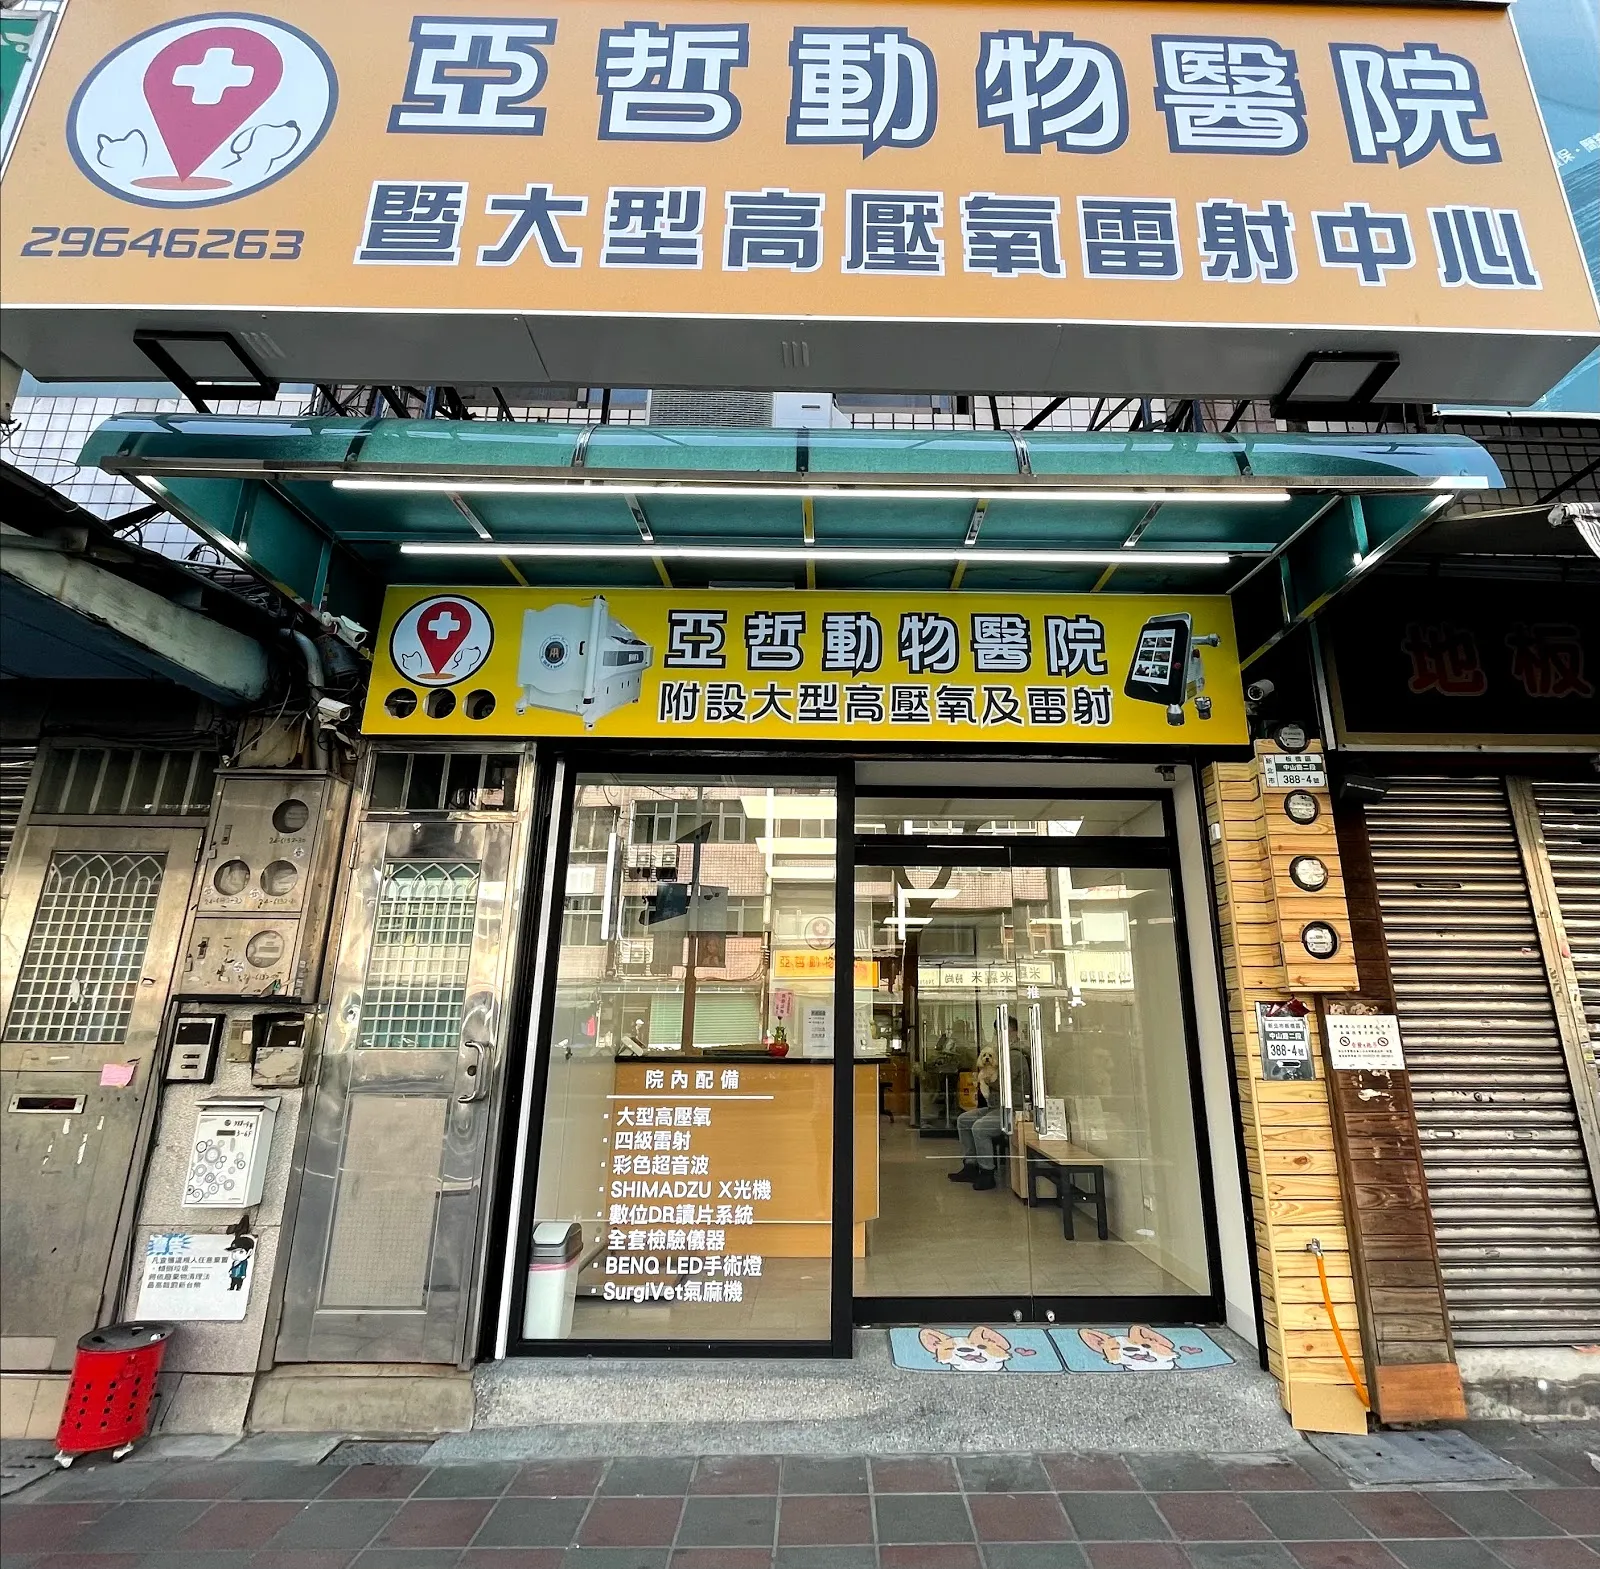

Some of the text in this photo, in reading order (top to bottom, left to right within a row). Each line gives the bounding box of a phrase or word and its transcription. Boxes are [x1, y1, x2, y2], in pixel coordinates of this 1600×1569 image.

[387, 15, 1501, 167] 亞哲動物醫院
[21, 227, 304, 260] 29646263
[353, 180, 1542, 290] 暨大型高壓氧雷射中心
[664, 608, 1109, 678] 亞哲動物醫院
[658, 681, 1113, 729] 附設大型高壓氧及雷射
[1026, 986, 1040, 999] 推
[645, 1069, 740, 1090] 院內配備
[616, 1106, 711, 1127] 大型高壓氧
[614, 1130, 691, 1151] 四級雷射
[612, 1154, 710, 1176] 彩色超音波
[610, 1179, 772, 1201] SHIMADZU X光機
[608, 1203, 754, 1226] 數位DR讀片系統
[607, 1229, 726, 1251] 全套檢驗儀器
[605, 1255, 763, 1277] BENQ LED手術燈
[603, 1280, 743, 1303] SurgiVet氣麻機
